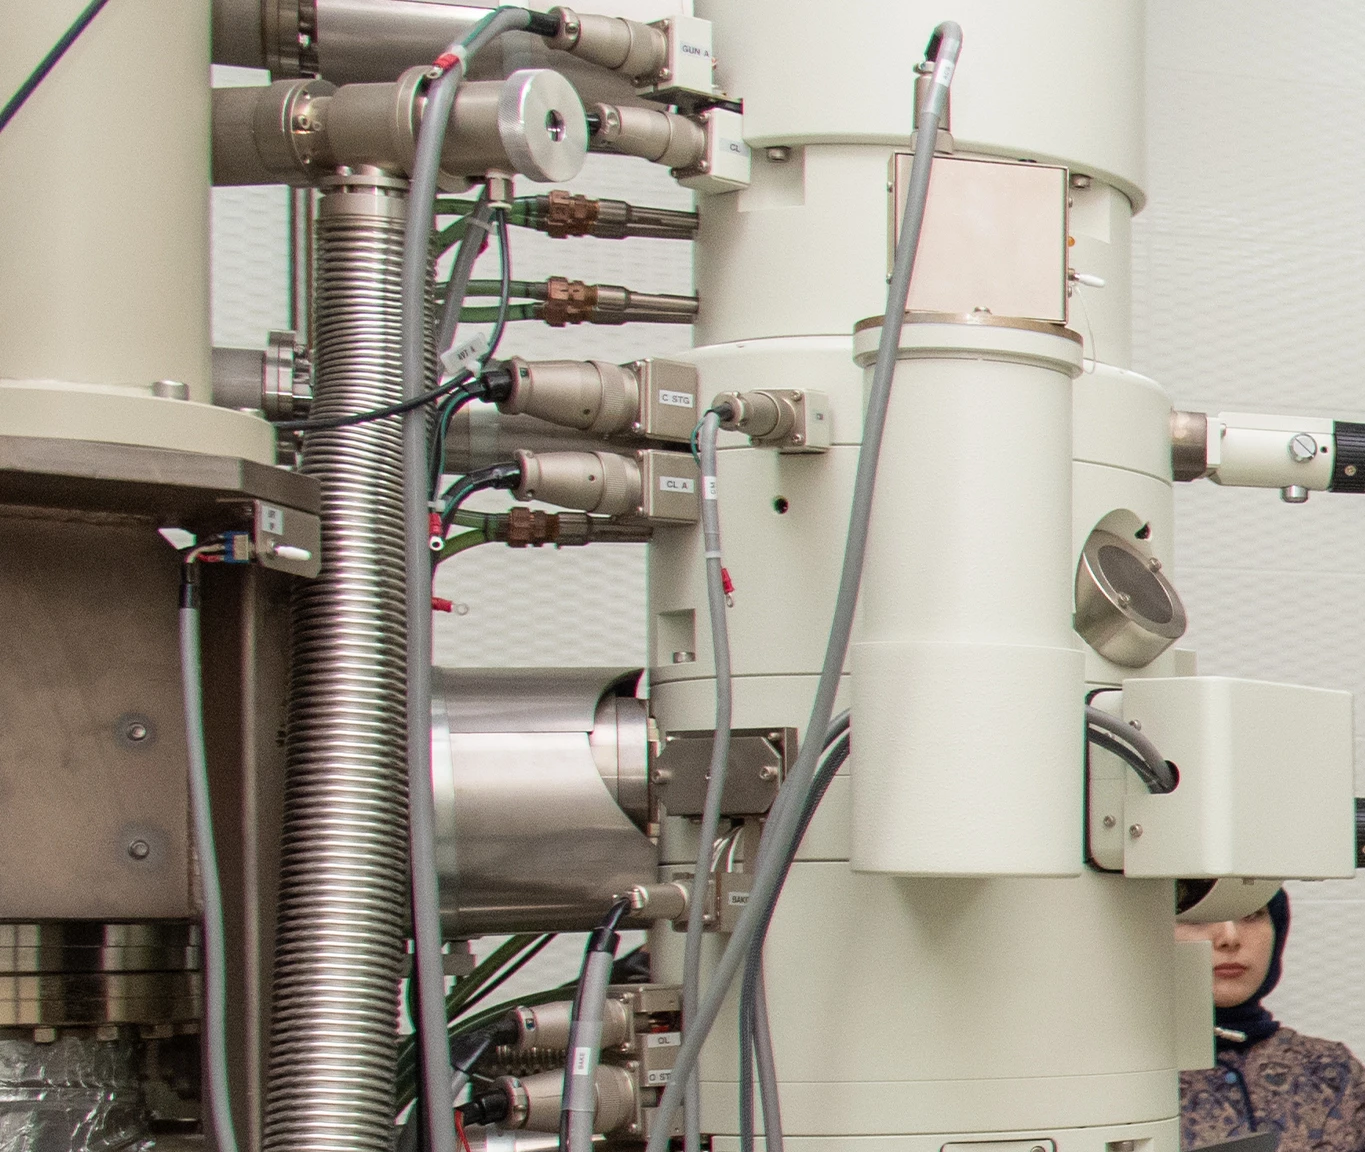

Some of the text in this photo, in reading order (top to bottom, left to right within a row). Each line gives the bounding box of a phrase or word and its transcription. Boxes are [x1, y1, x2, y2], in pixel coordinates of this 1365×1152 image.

[682, 45, 700, 56] GUN
[730, 143, 741, 152] CL
[662, 394, 690, 404] C STG
[666, 480, 678, 489] CL
